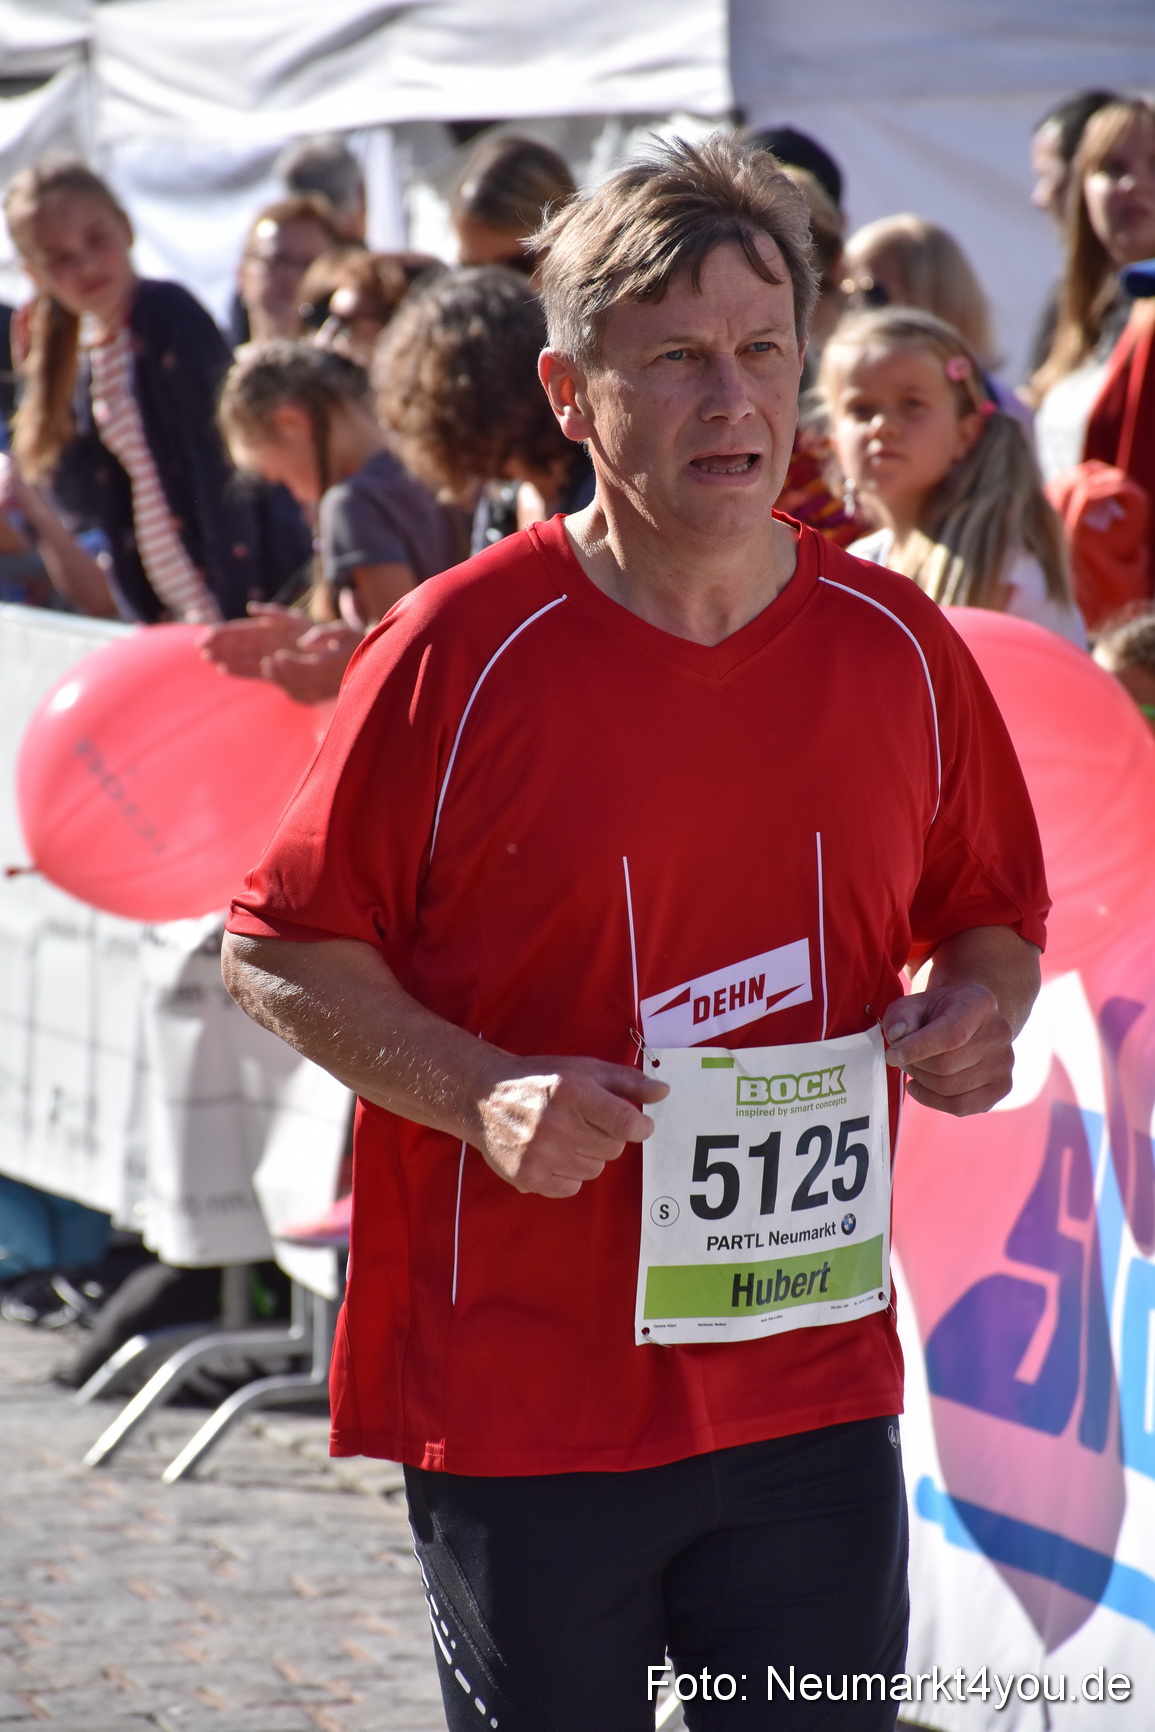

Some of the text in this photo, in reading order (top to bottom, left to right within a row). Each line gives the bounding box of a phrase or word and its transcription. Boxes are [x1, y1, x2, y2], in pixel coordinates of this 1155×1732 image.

[693, 973, 766, 1025] DEHN
[736, 1064, 847, 1106] BOCK
[736, 1097, 847, 1118] inspired by smart concepts
[689, 1115, 870, 1220] 5125
[659, 1204, 670, 1220] S
[706, 1233, 764, 1251] PARTL
[768, 1221, 837, 1247] Neumarkt
[731, 1261, 831, 1307] Hubert
